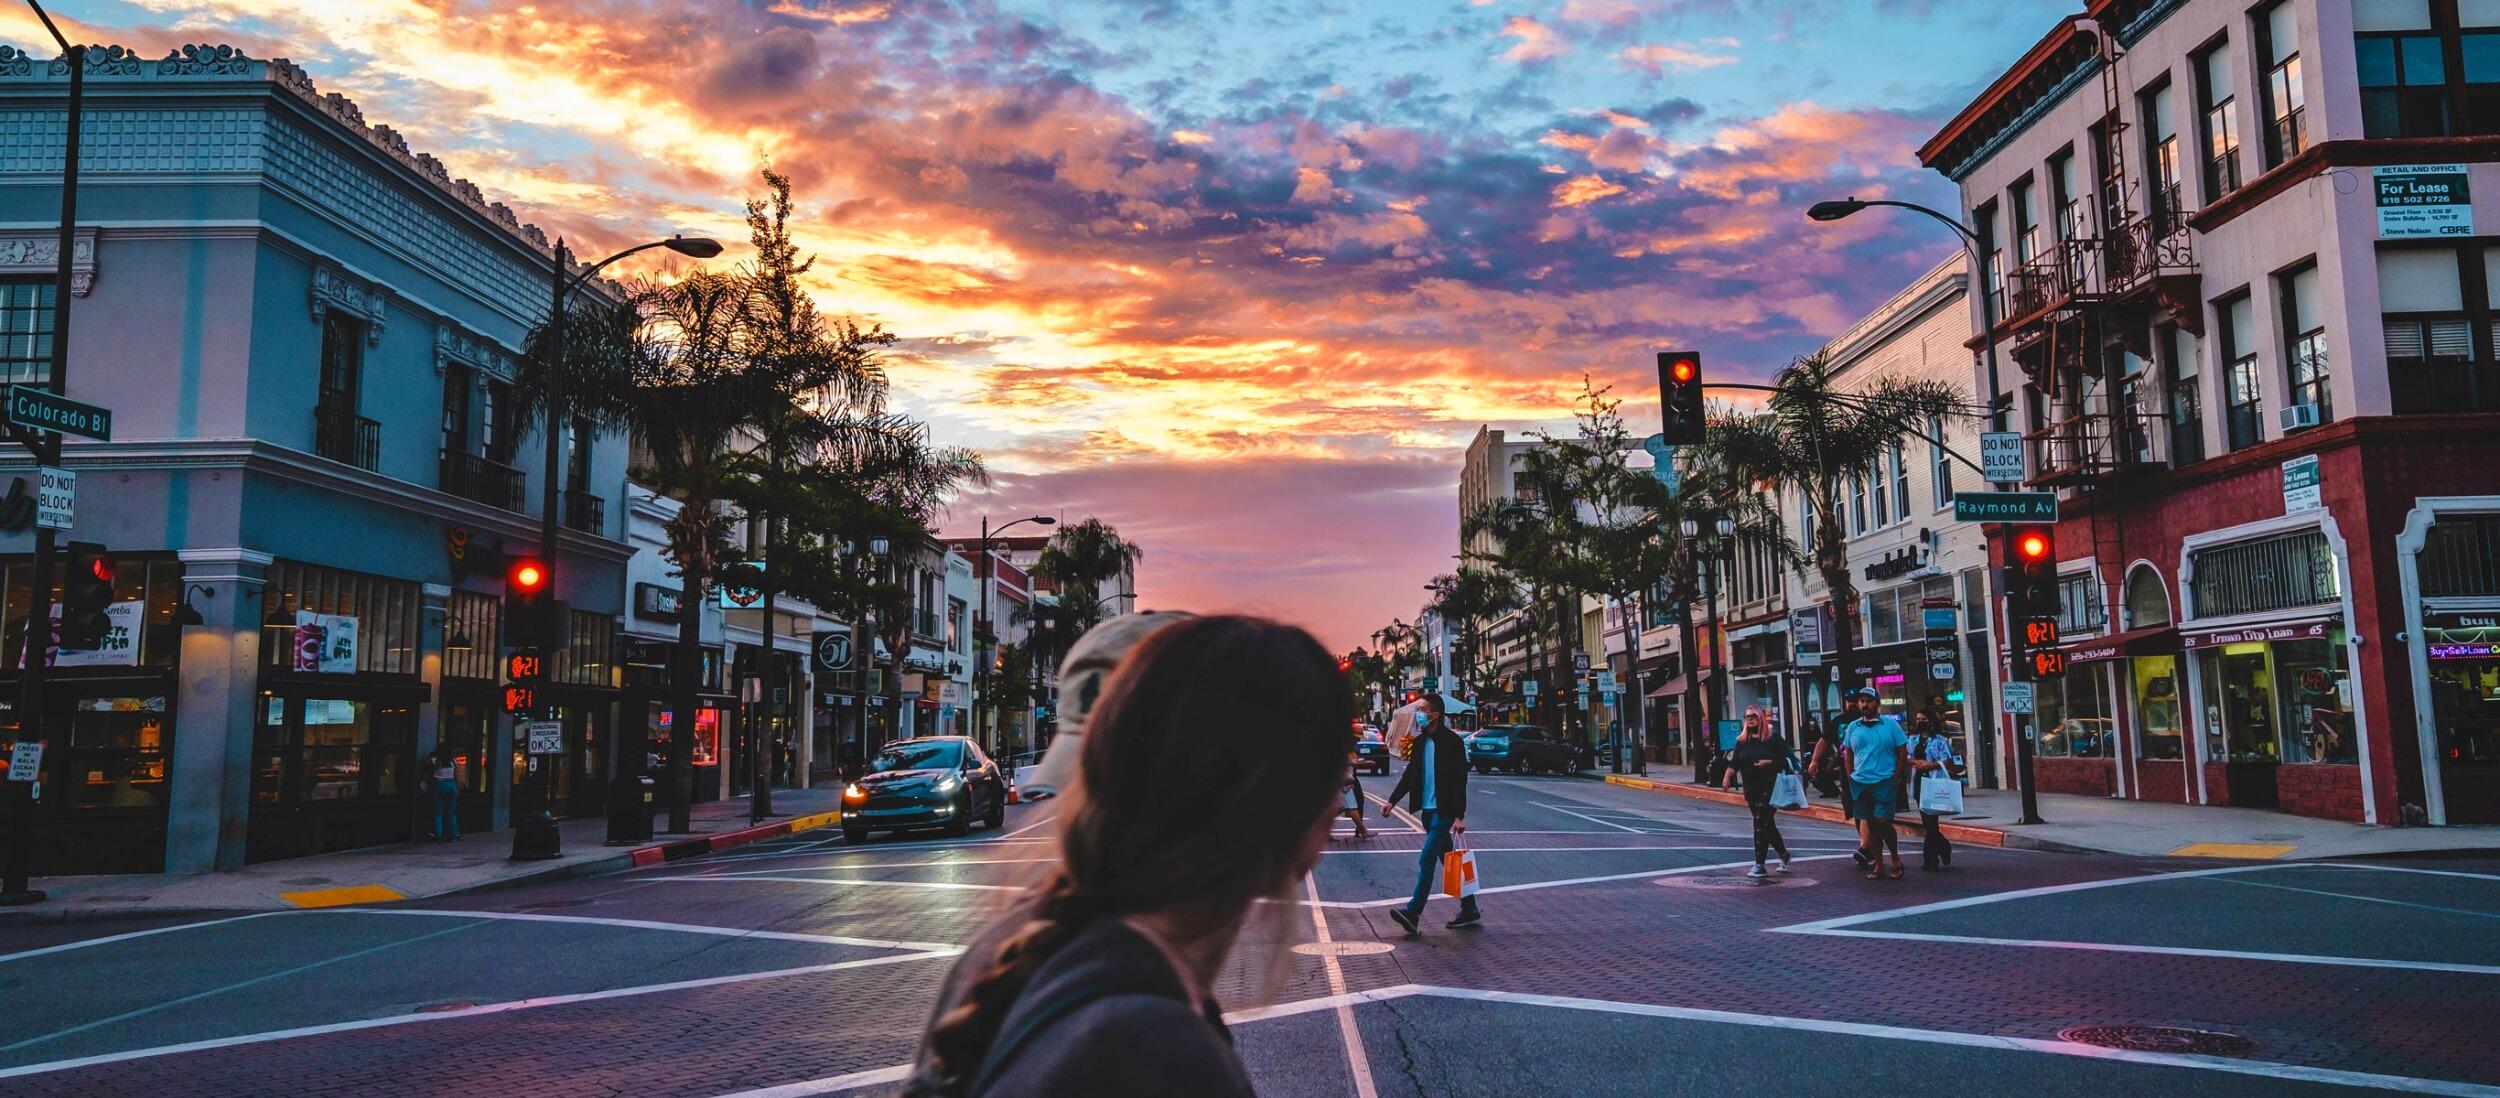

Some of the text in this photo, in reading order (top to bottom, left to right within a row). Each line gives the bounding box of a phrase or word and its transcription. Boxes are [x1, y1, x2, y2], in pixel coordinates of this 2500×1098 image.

[2431, 165, 2457, 173] OFFICE
[2381, 182, 2449, 194] For Lease
[2382, 195, 2450, 204] 818 502 6726
[2440, 225, 2471, 234] CBRE
[18, 396, 106, 433] Colorado Bl
[1983, 438, 2020, 450] DO NOT
[1984, 454, 2022, 466] BLOCK
[1986, 468, 2023, 478] INTERSECTION
[41, 474, 75, 491] DO NOT
[40, 493, 73, 510] BLOCK
[1958, 501, 2053, 515] Raymond Av
[39, 510, 73, 523] INTERSECTION
[106, 605, 131, 615] amba
[2460, 615, 2497, 627] buy
[2039, 622, 2055, 640] 21
[2243, 630, 2265, 641] City
[2266, 628, 2294, 639] Loan
[2309, 625, 2323, 636] 65
[2184, 637, 2196, 647] 65
[2048, 654, 2062, 673] 21
[2004, 700, 2017, 710] OK
[531, 740, 544, 751] OK
